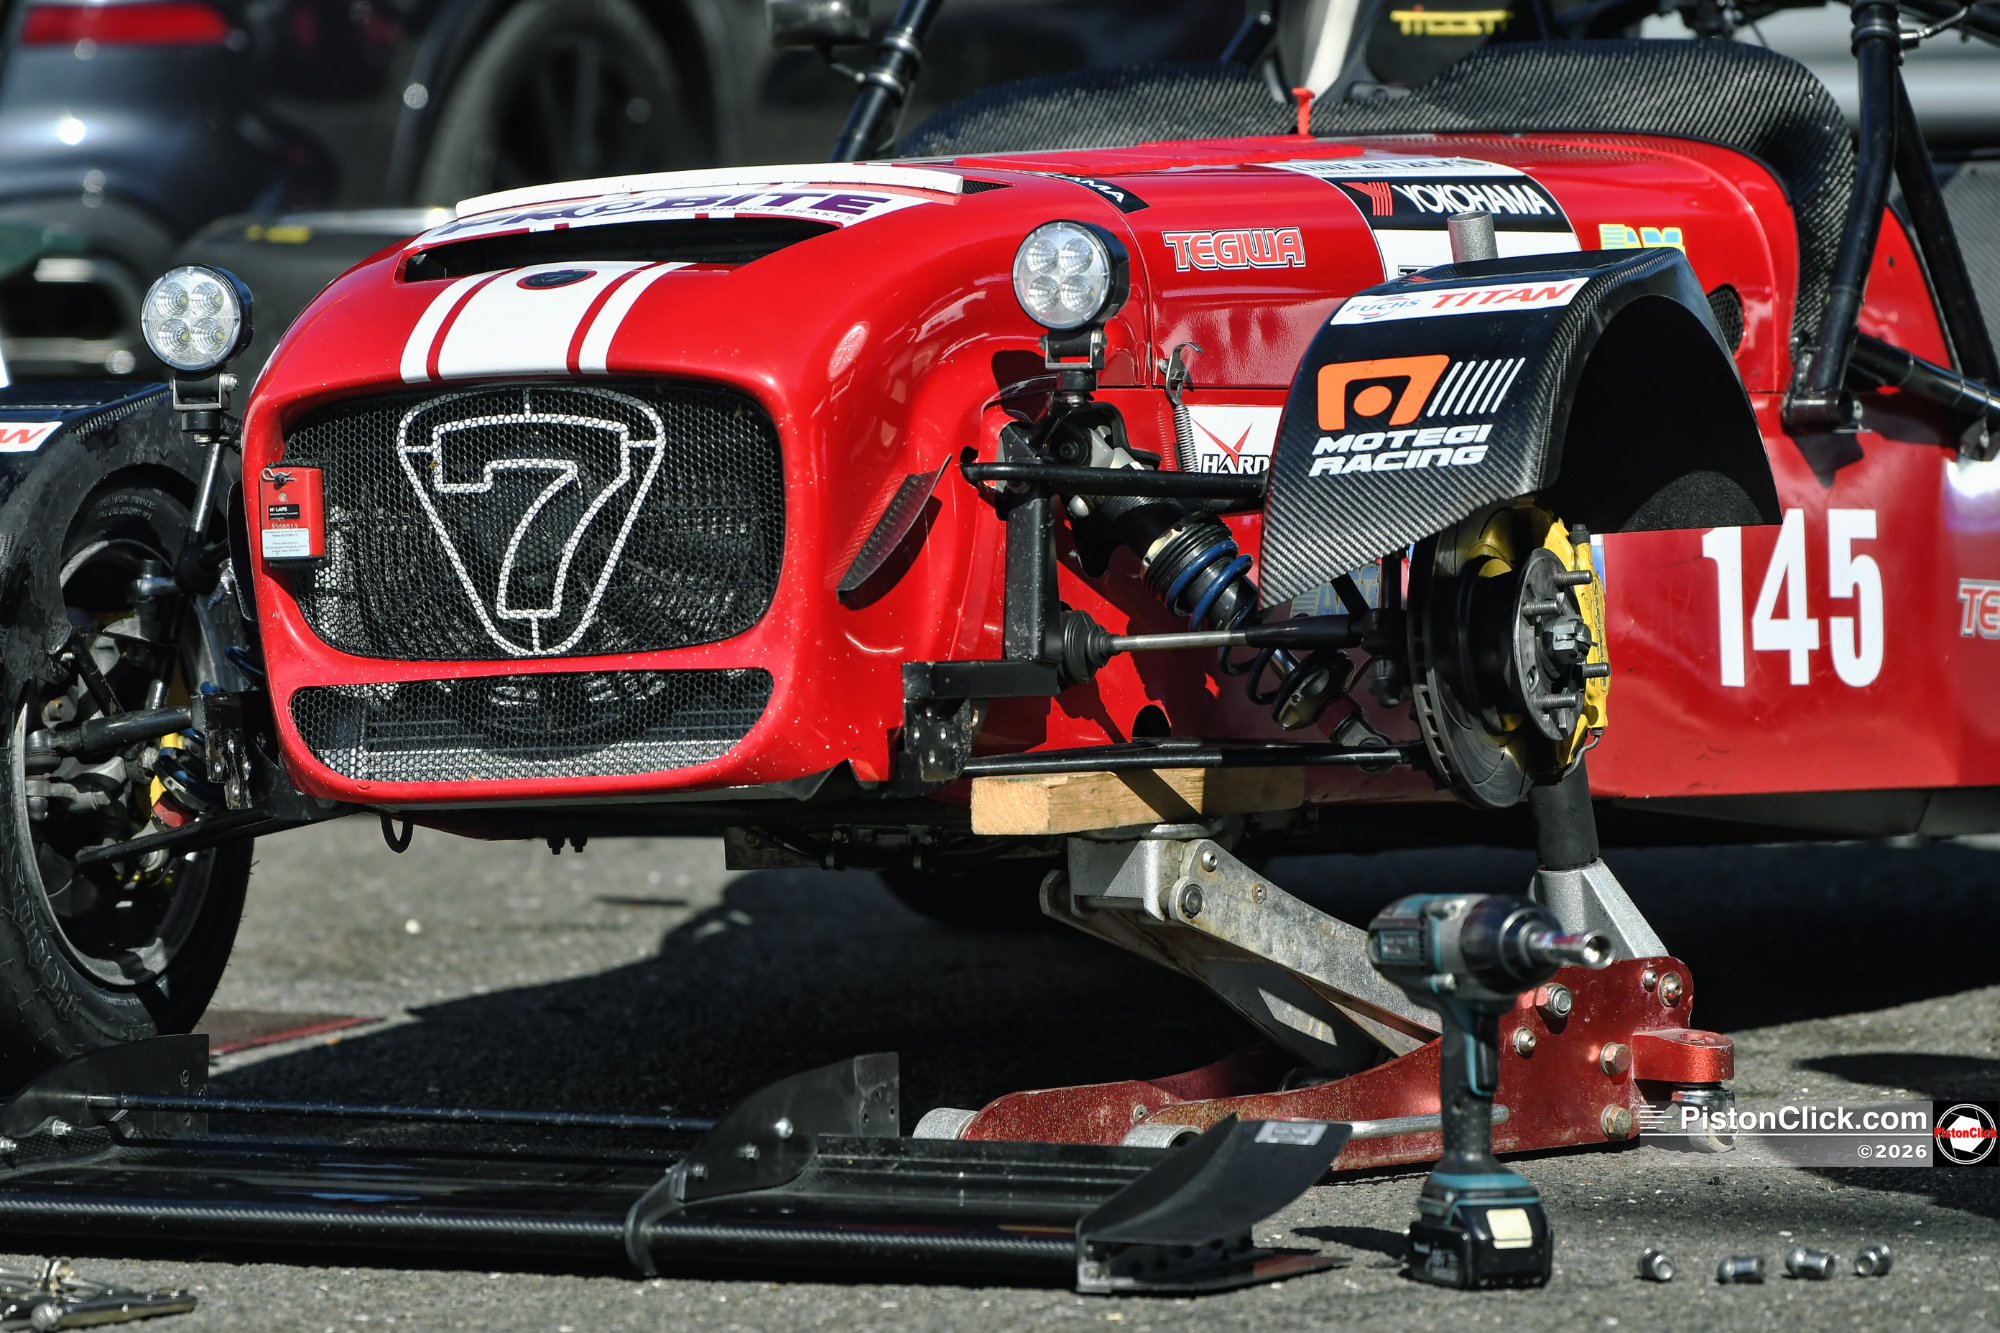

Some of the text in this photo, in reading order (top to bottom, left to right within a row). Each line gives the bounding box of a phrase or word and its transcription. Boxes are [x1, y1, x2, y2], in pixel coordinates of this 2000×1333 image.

[638, 206, 856, 221] PERFORMANCE BRAKES
[1391, 184, 1556, 216] YOKOHAMA
[1162, 227, 1306, 272] TEGIWA
[1345, 283, 1576, 313] FUCHS TITAN
[1311, 423, 1494, 456] MOTEGI
[1308, 444, 1490, 478] RACING
[1702, 508, 1884, 688] 145
